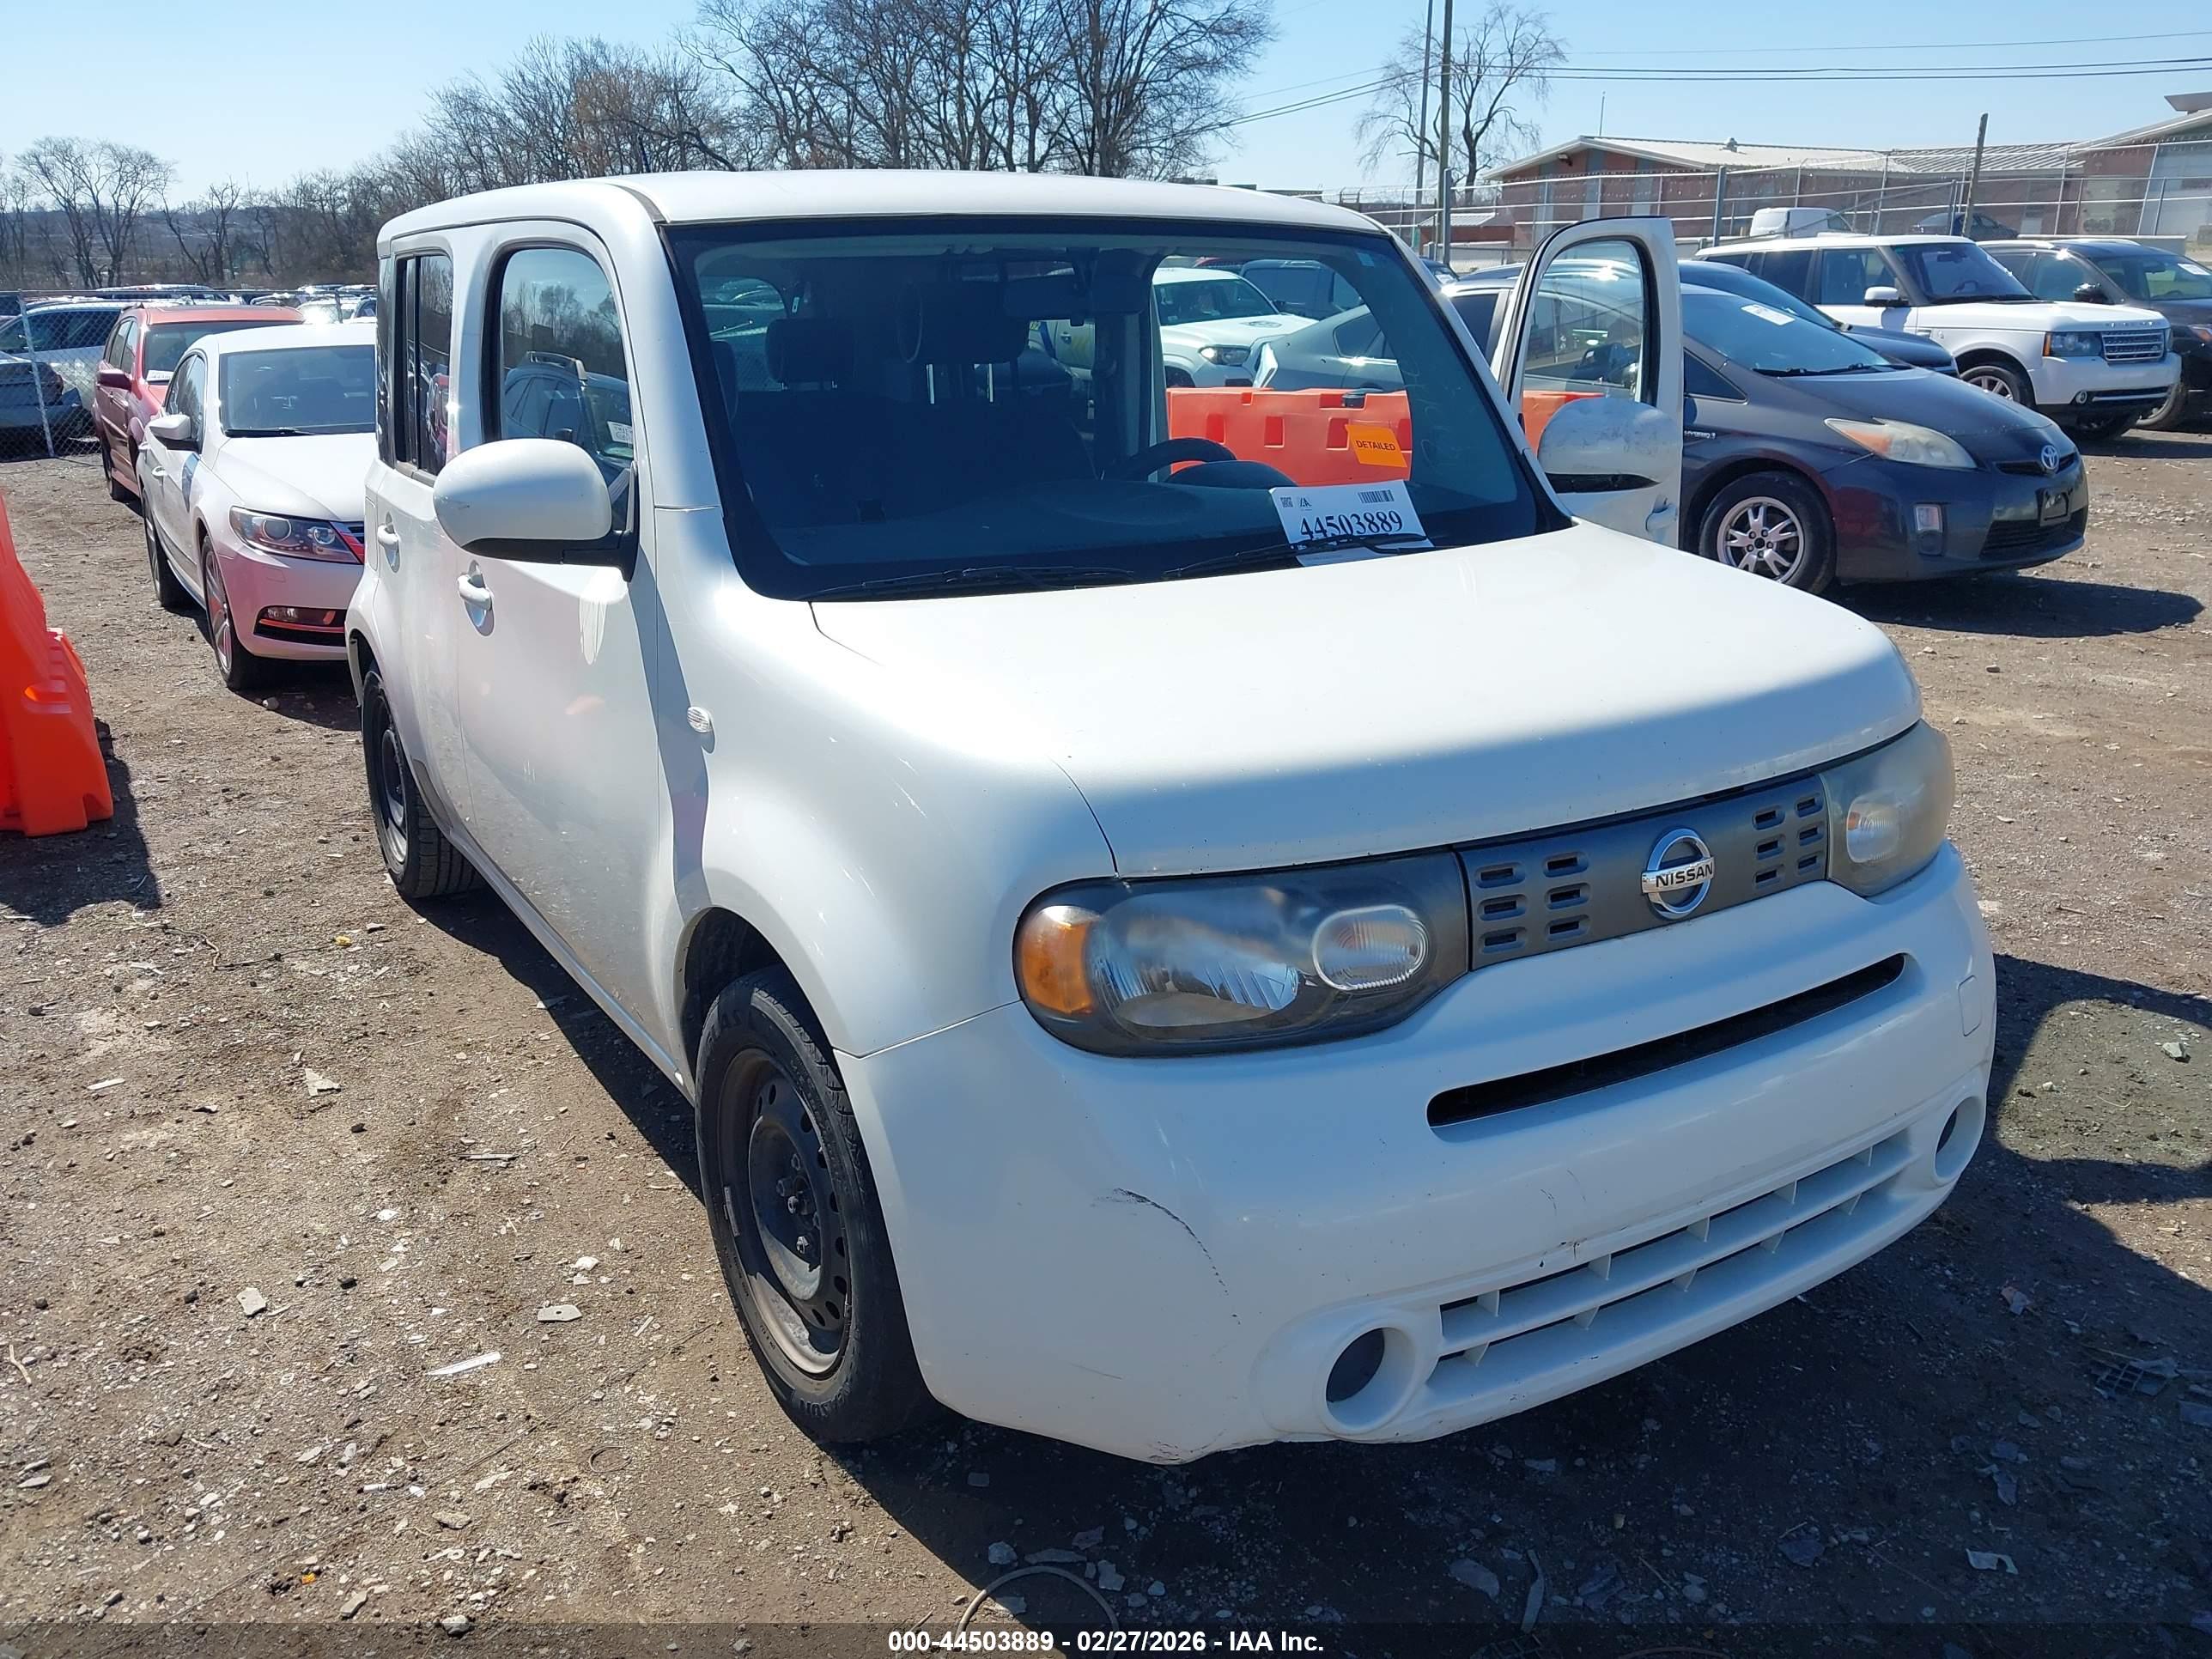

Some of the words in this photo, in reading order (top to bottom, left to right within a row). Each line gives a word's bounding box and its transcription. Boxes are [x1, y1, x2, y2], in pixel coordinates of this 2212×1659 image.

[1355, 440, 1396, 451] DETAILED
[1300, 510, 1403, 540] 44503889
[1655, 861, 1714, 888] NISSAN
